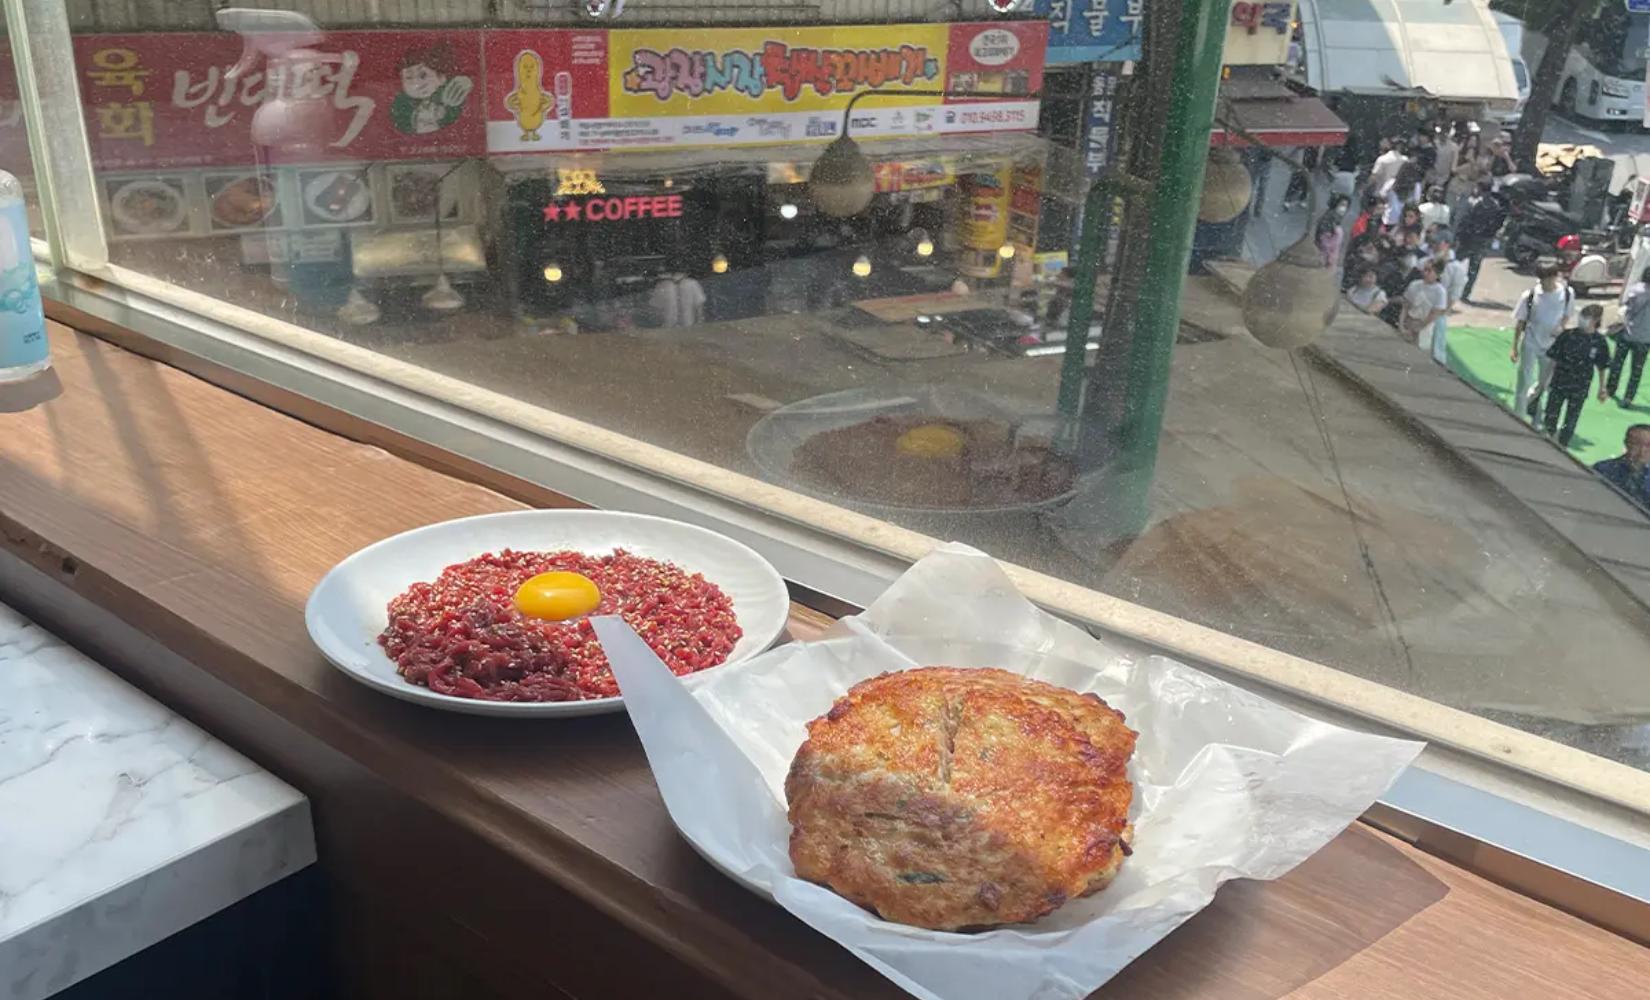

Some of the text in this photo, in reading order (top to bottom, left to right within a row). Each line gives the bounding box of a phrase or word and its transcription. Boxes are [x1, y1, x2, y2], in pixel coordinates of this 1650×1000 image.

[86, 48, 155, 145] 육회
[172, 50, 376, 147] 빈대떡
[585, 195, 684, 222] COFFEE
